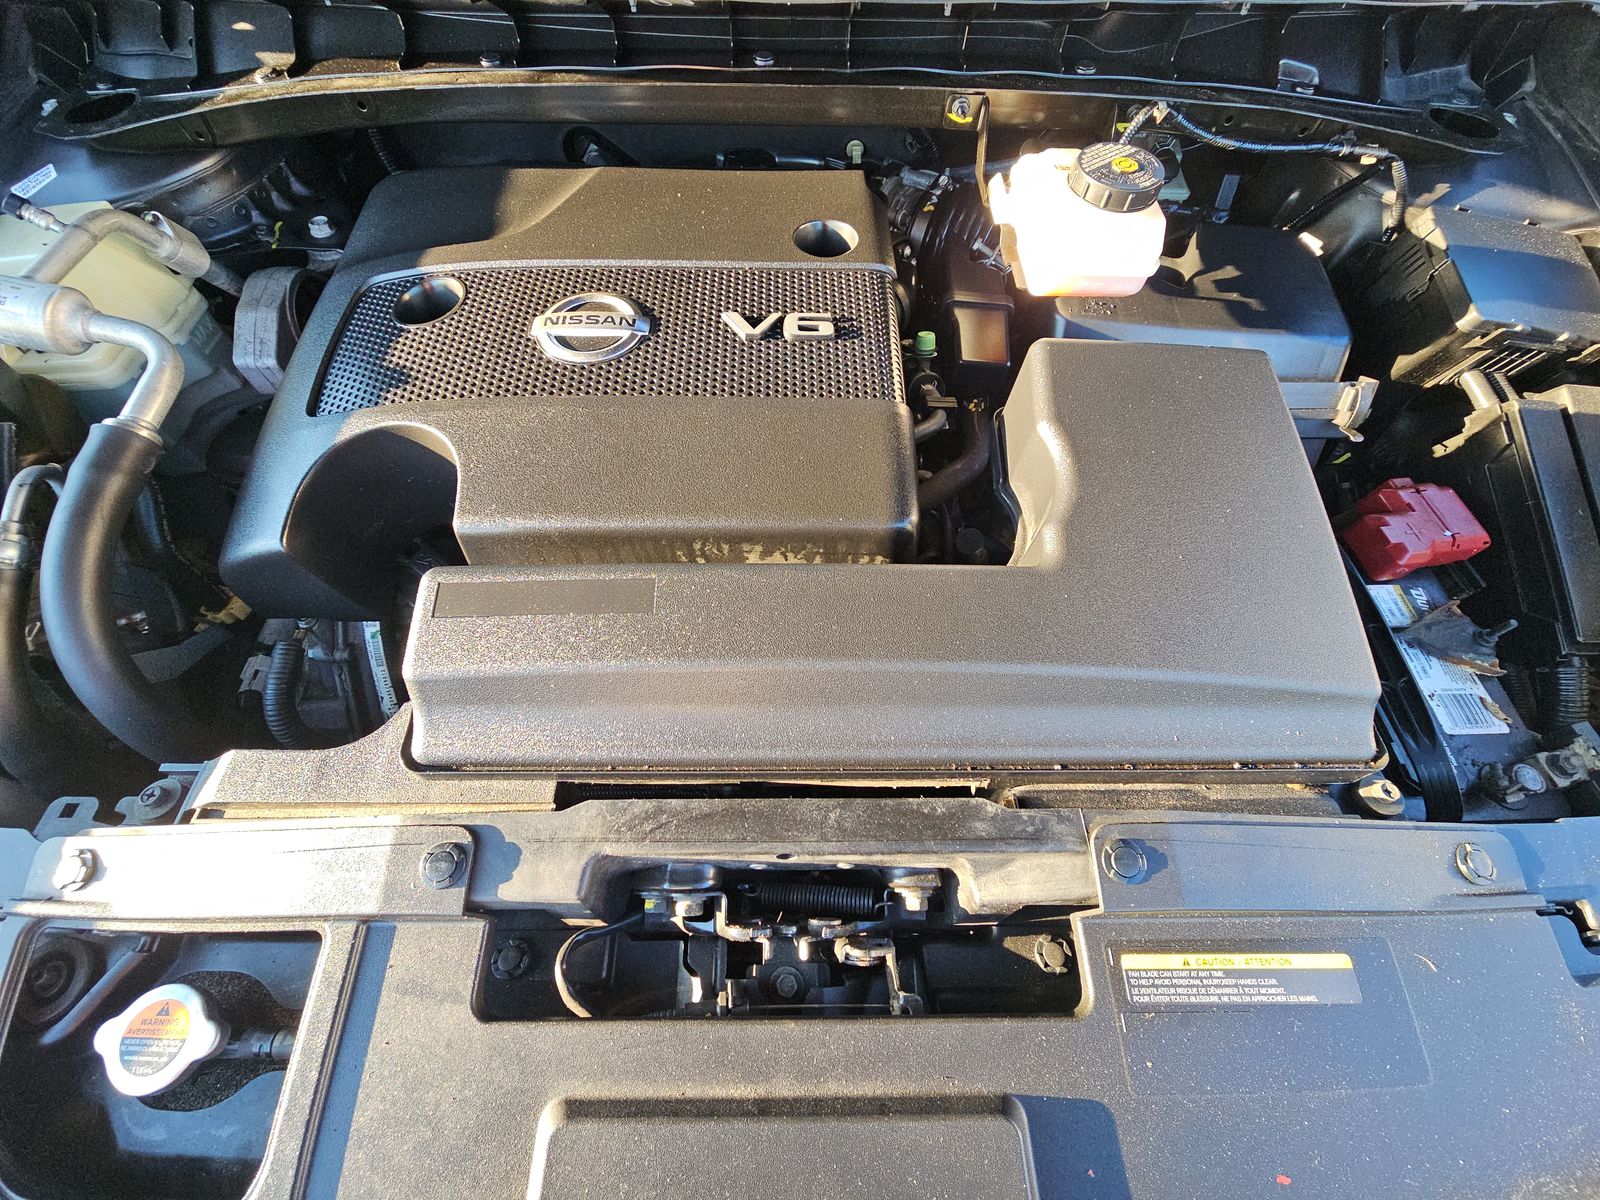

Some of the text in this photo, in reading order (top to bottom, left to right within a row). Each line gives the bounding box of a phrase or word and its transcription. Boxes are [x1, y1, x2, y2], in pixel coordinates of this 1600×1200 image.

[543, 314, 638, 328] NISSAN
[721, 312, 835, 341] V6
[1196, 958, 1292, 966] CAUTION ATTENTION
[140, 1018, 180, 1026] WARNING
